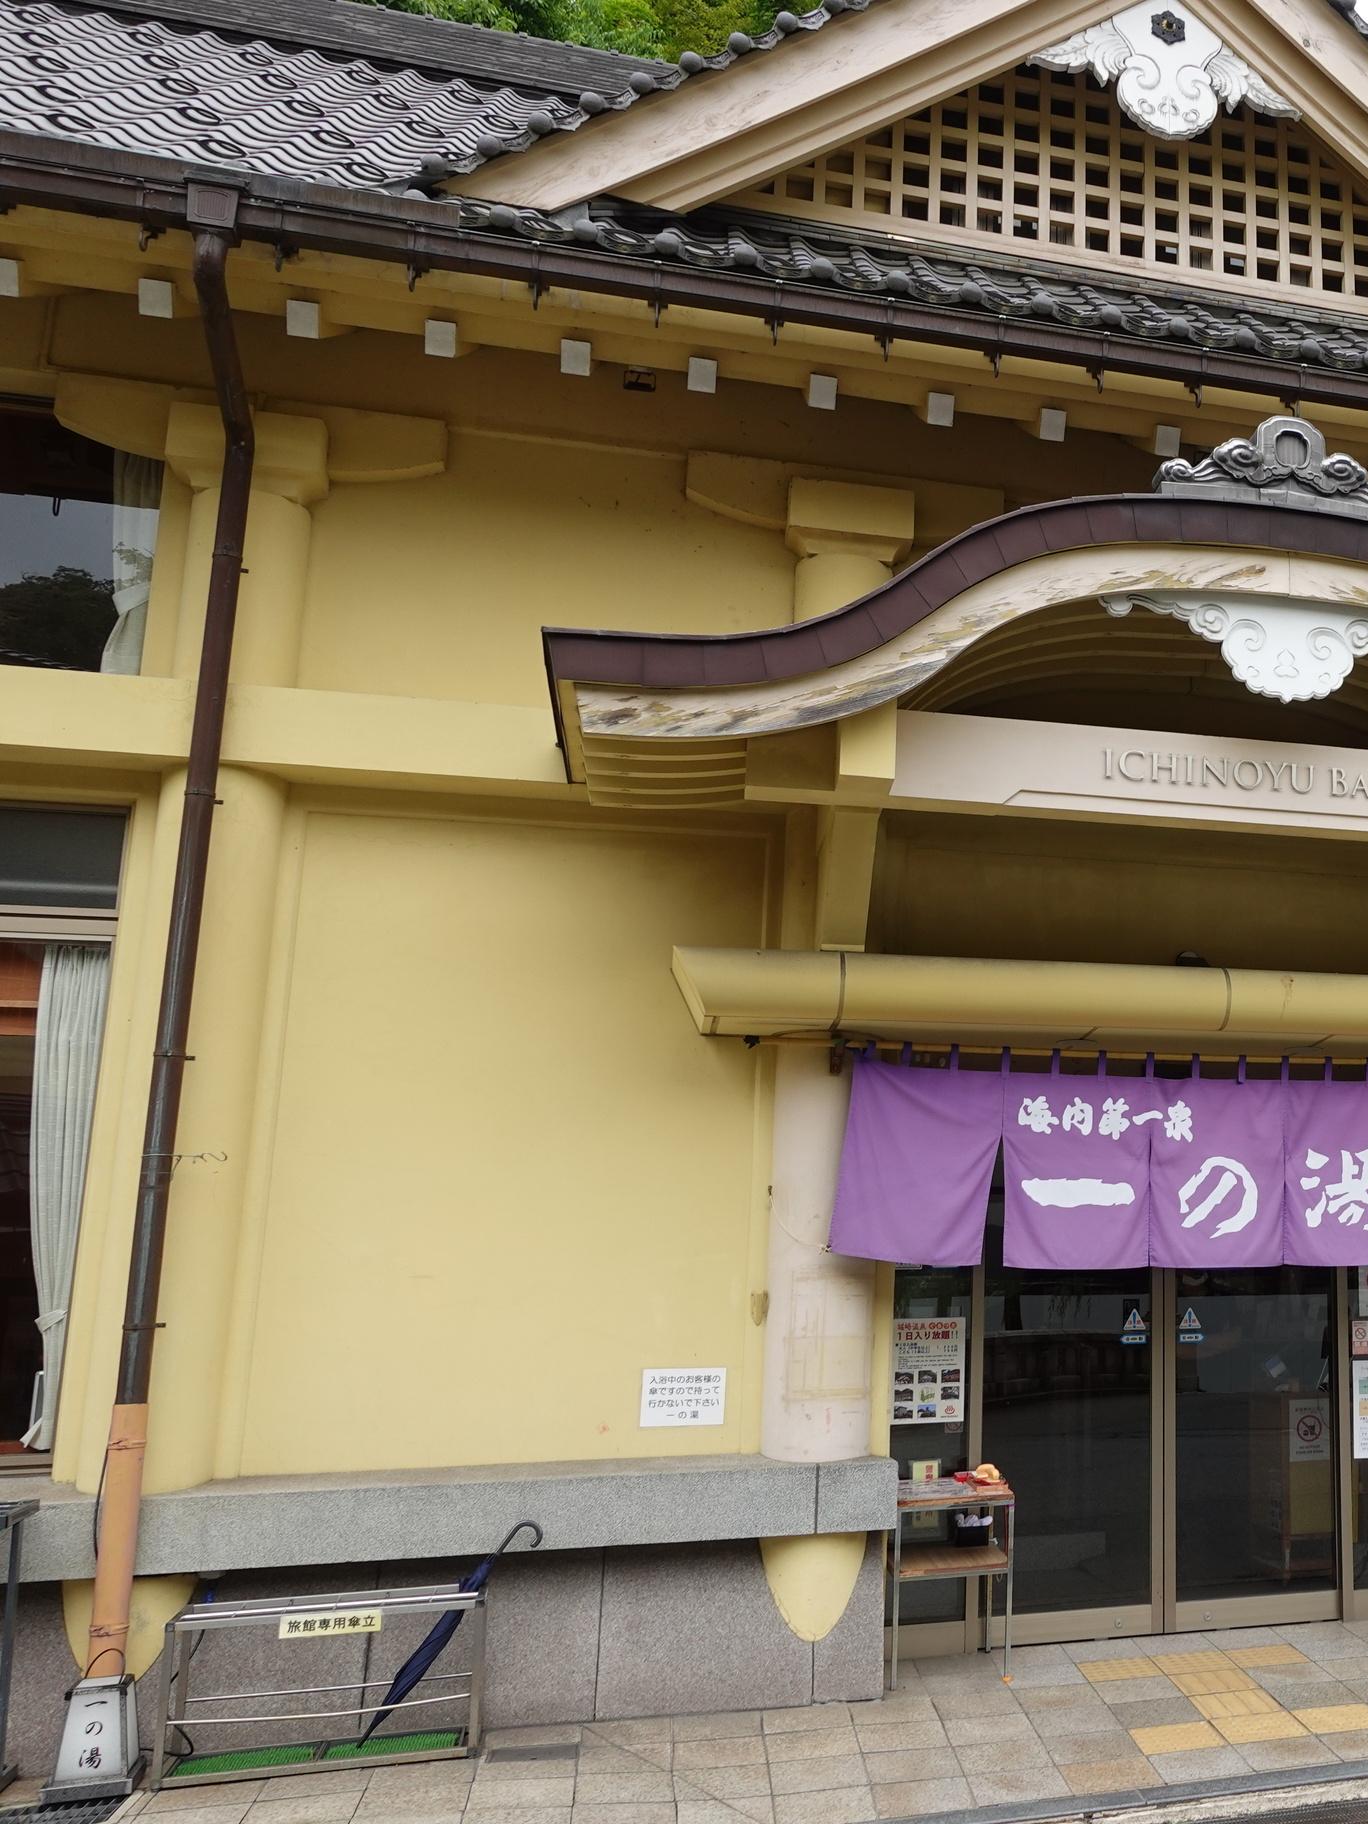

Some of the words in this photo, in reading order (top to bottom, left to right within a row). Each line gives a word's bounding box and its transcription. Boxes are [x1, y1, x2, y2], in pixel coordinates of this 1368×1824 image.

[1103, 748, 1315, 796] ICHINOYU
[1018, 1096, 1194, 1143] 海内第一泉
[649, 1374, 721, 1385] 入浴中のお客様の
[648, 1386, 720, 1396] 傘ですので持って
[648, 1398, 720, 1408] 行かないで下さい
[287, 1615, 376, 1633] 旅館専用傘立
[78, 1701, 108, 1769] 一の湯
